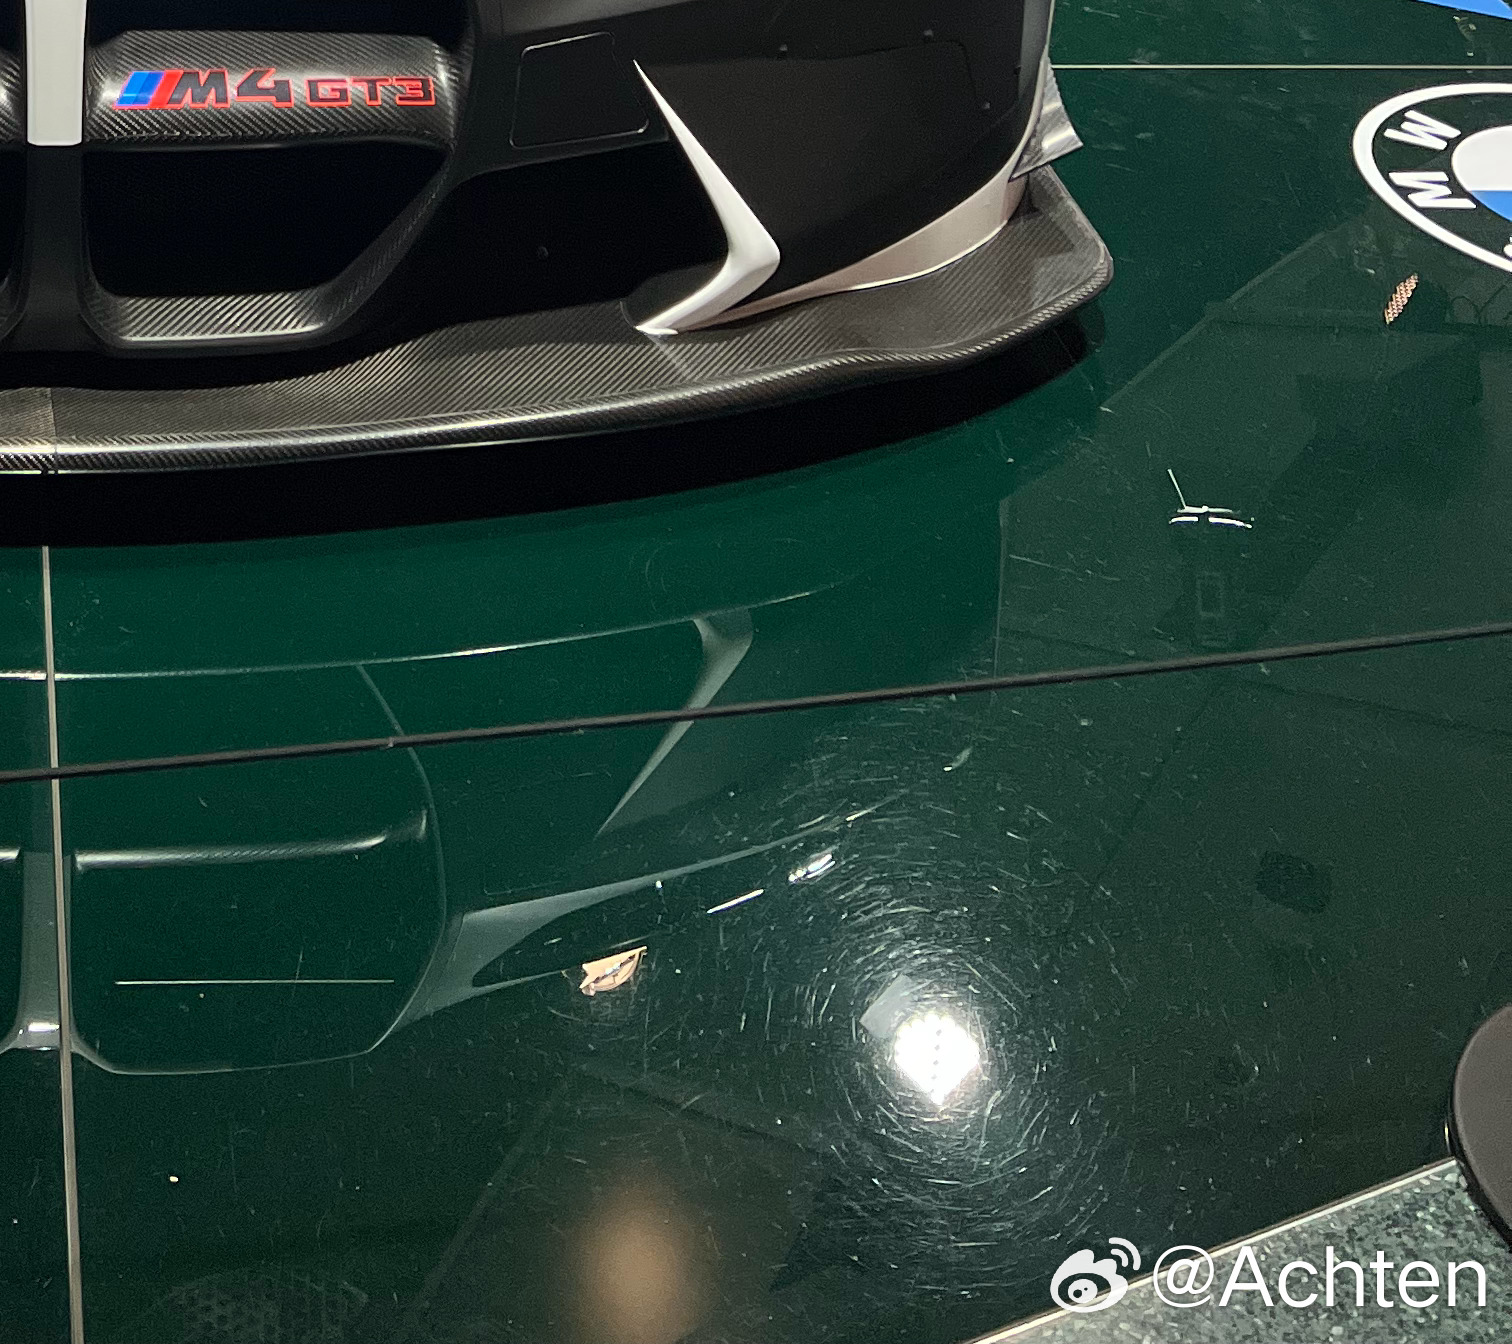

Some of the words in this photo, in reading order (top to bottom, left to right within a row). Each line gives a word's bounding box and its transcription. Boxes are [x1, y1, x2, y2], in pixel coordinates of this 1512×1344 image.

[162, 68, 295, 110] M4
[305, 76, 436, 108] GT3
[1383, 109, 1512, 258] MW
